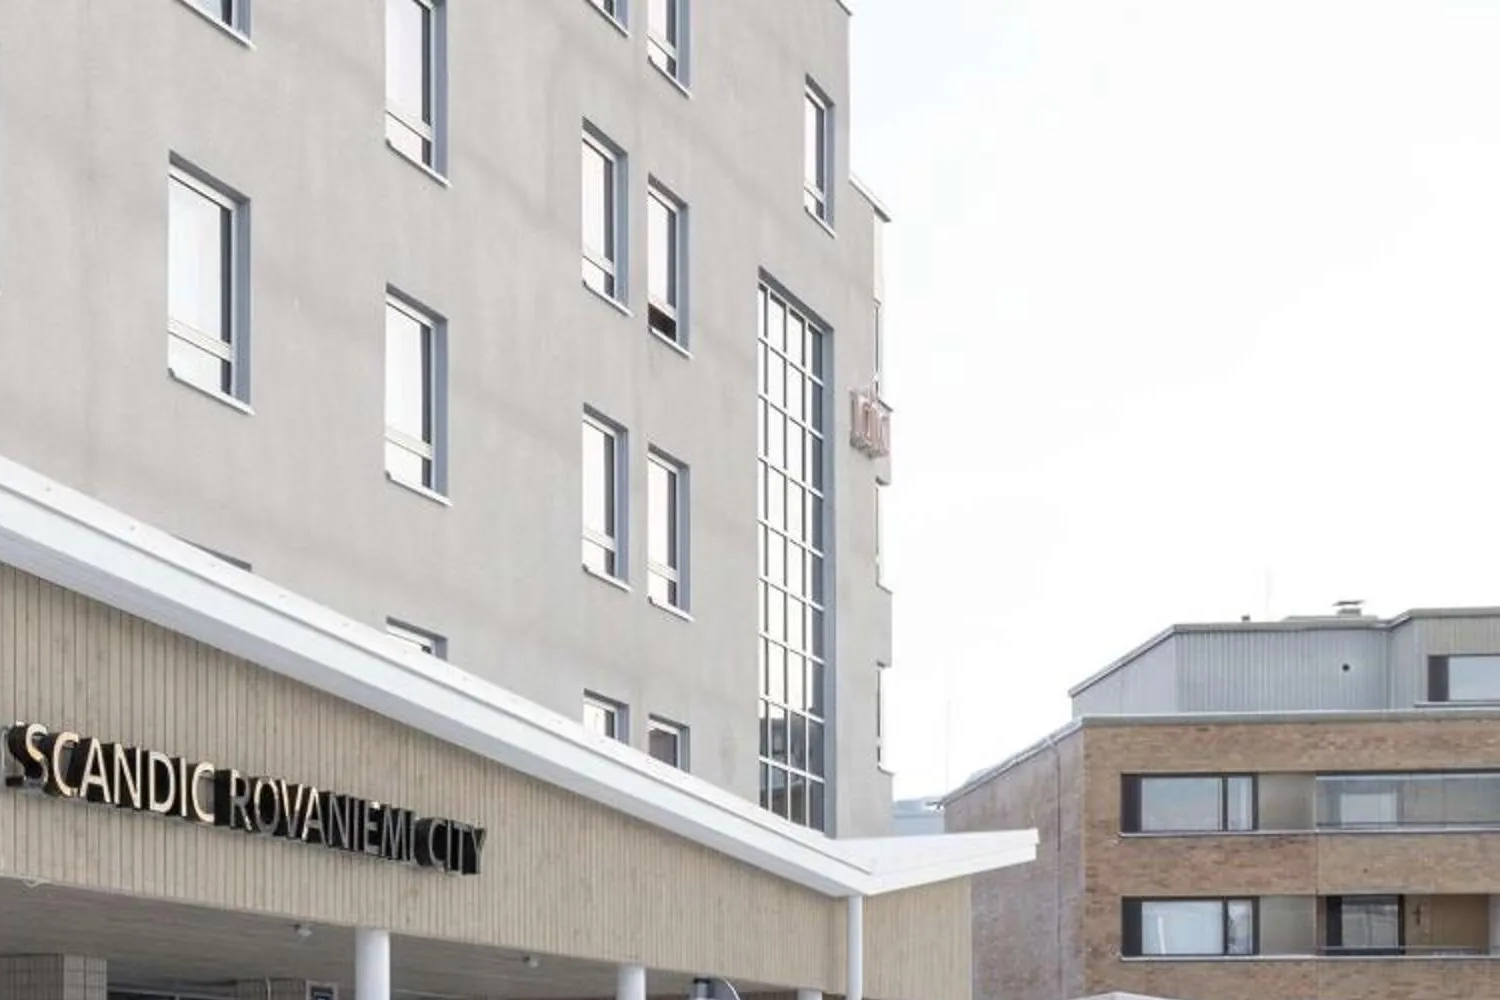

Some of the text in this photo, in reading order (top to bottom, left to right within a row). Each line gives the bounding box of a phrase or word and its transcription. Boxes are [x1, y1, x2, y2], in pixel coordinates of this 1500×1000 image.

[21, 723, 487, 876] SCANDIC ROVANIEMI CITY
